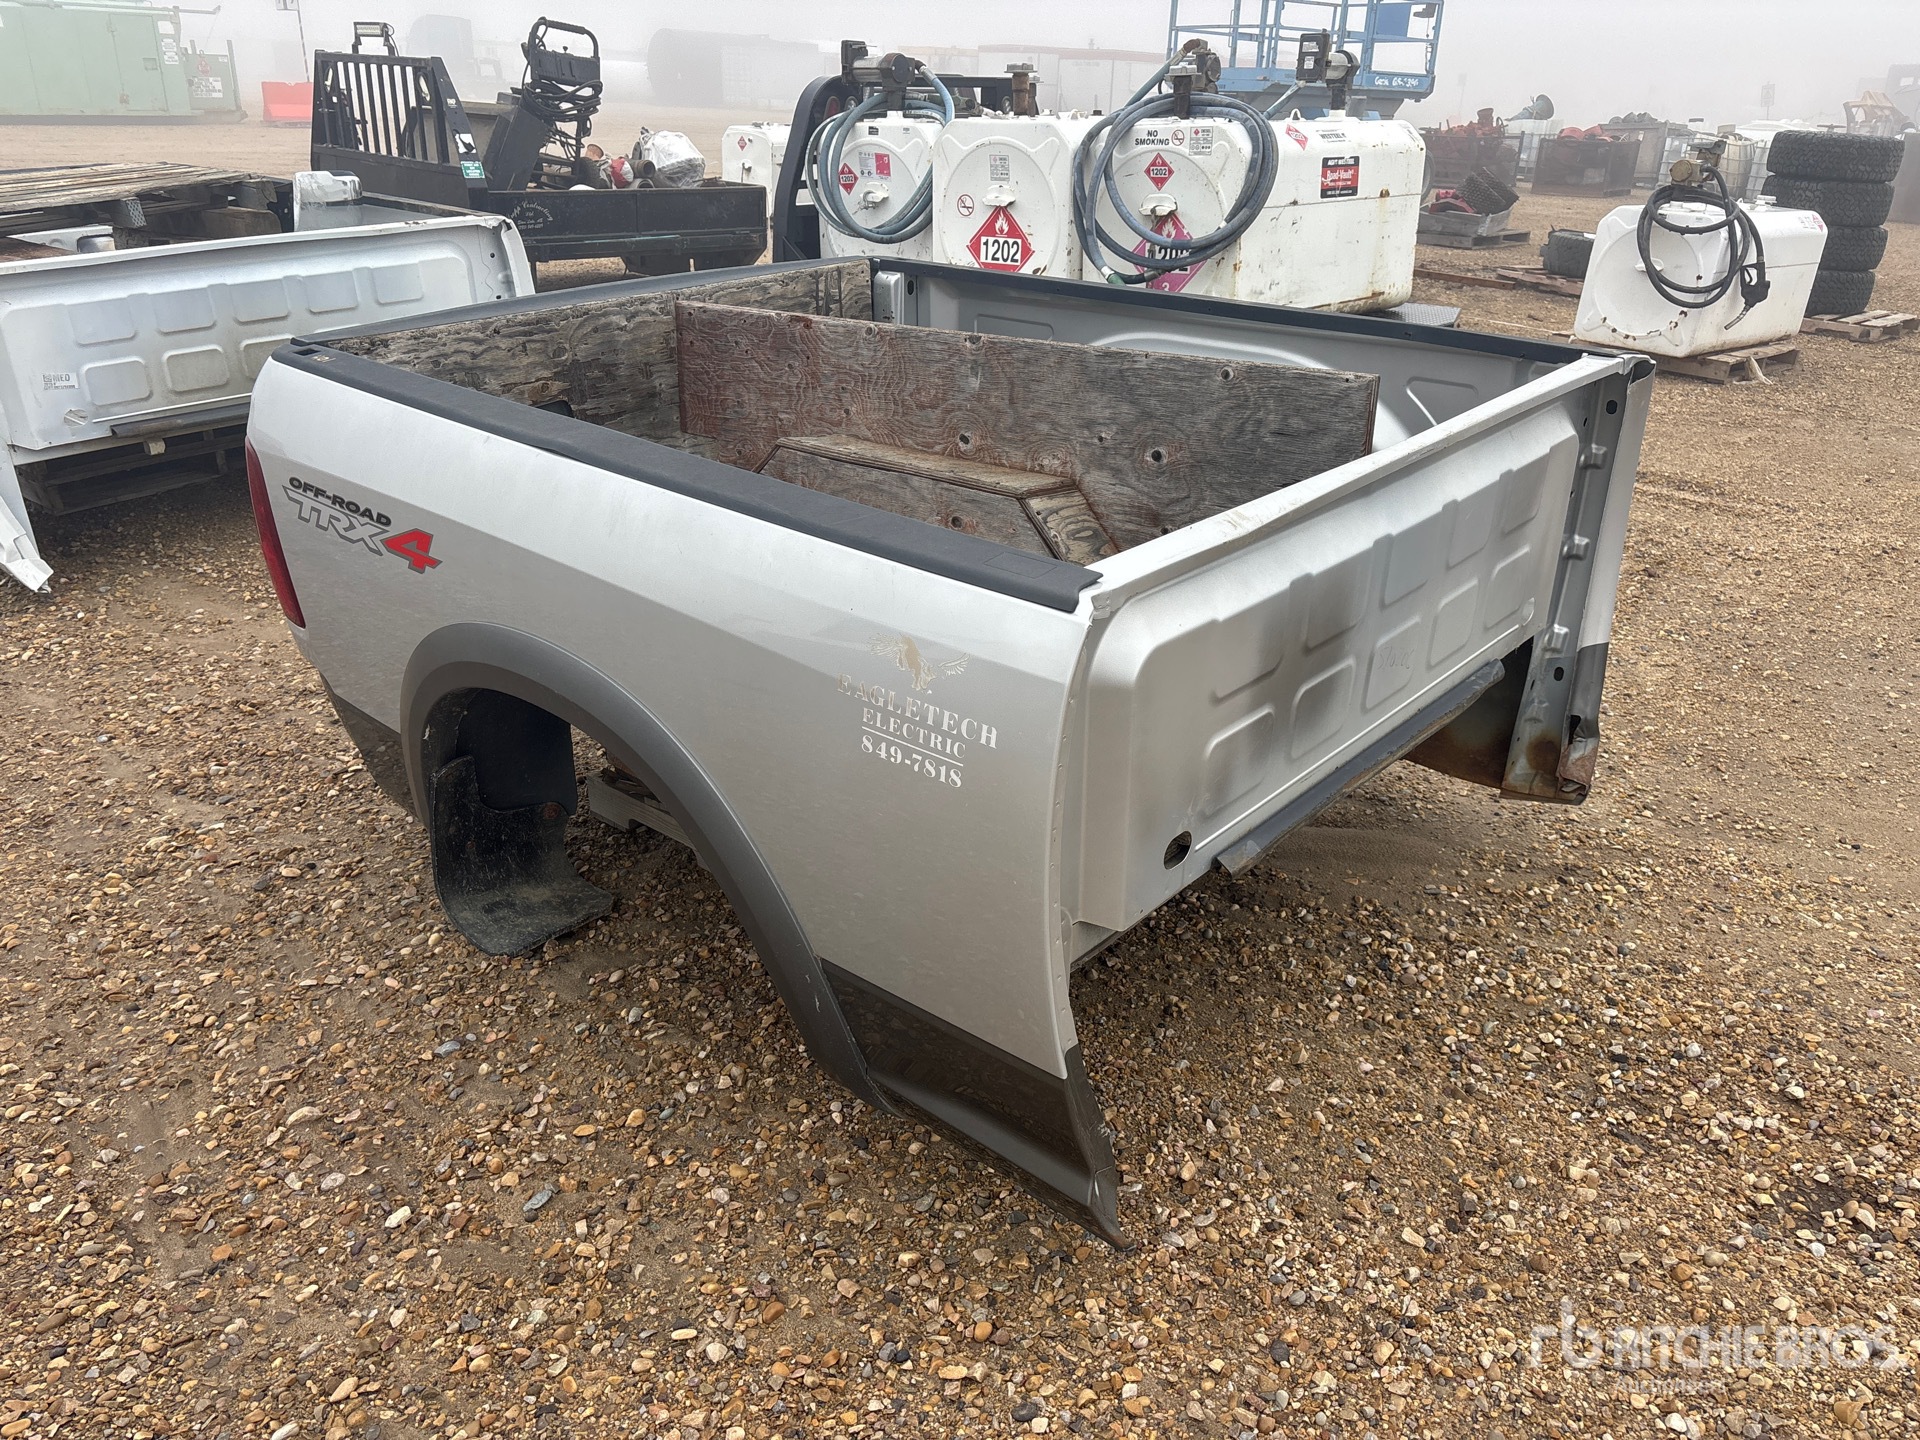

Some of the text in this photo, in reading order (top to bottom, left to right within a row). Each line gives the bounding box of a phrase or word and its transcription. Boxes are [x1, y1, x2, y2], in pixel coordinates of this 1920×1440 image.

[1134, 138, 1170, 146] SMOKING
[1146, 130, 1158, 138] NO
[840, 174, 854, 183] 1202
[1151, 167, 1168, 176] 1202
[983, 238, 1020, 264] 1202
[288, 476, 392, 527] OFF-ROAD
[837, 674, 998, 749] EAGLETECH
[862, 707, 966, 759] ELECTRIC
[861, 734, 962, 788] 849-7818
